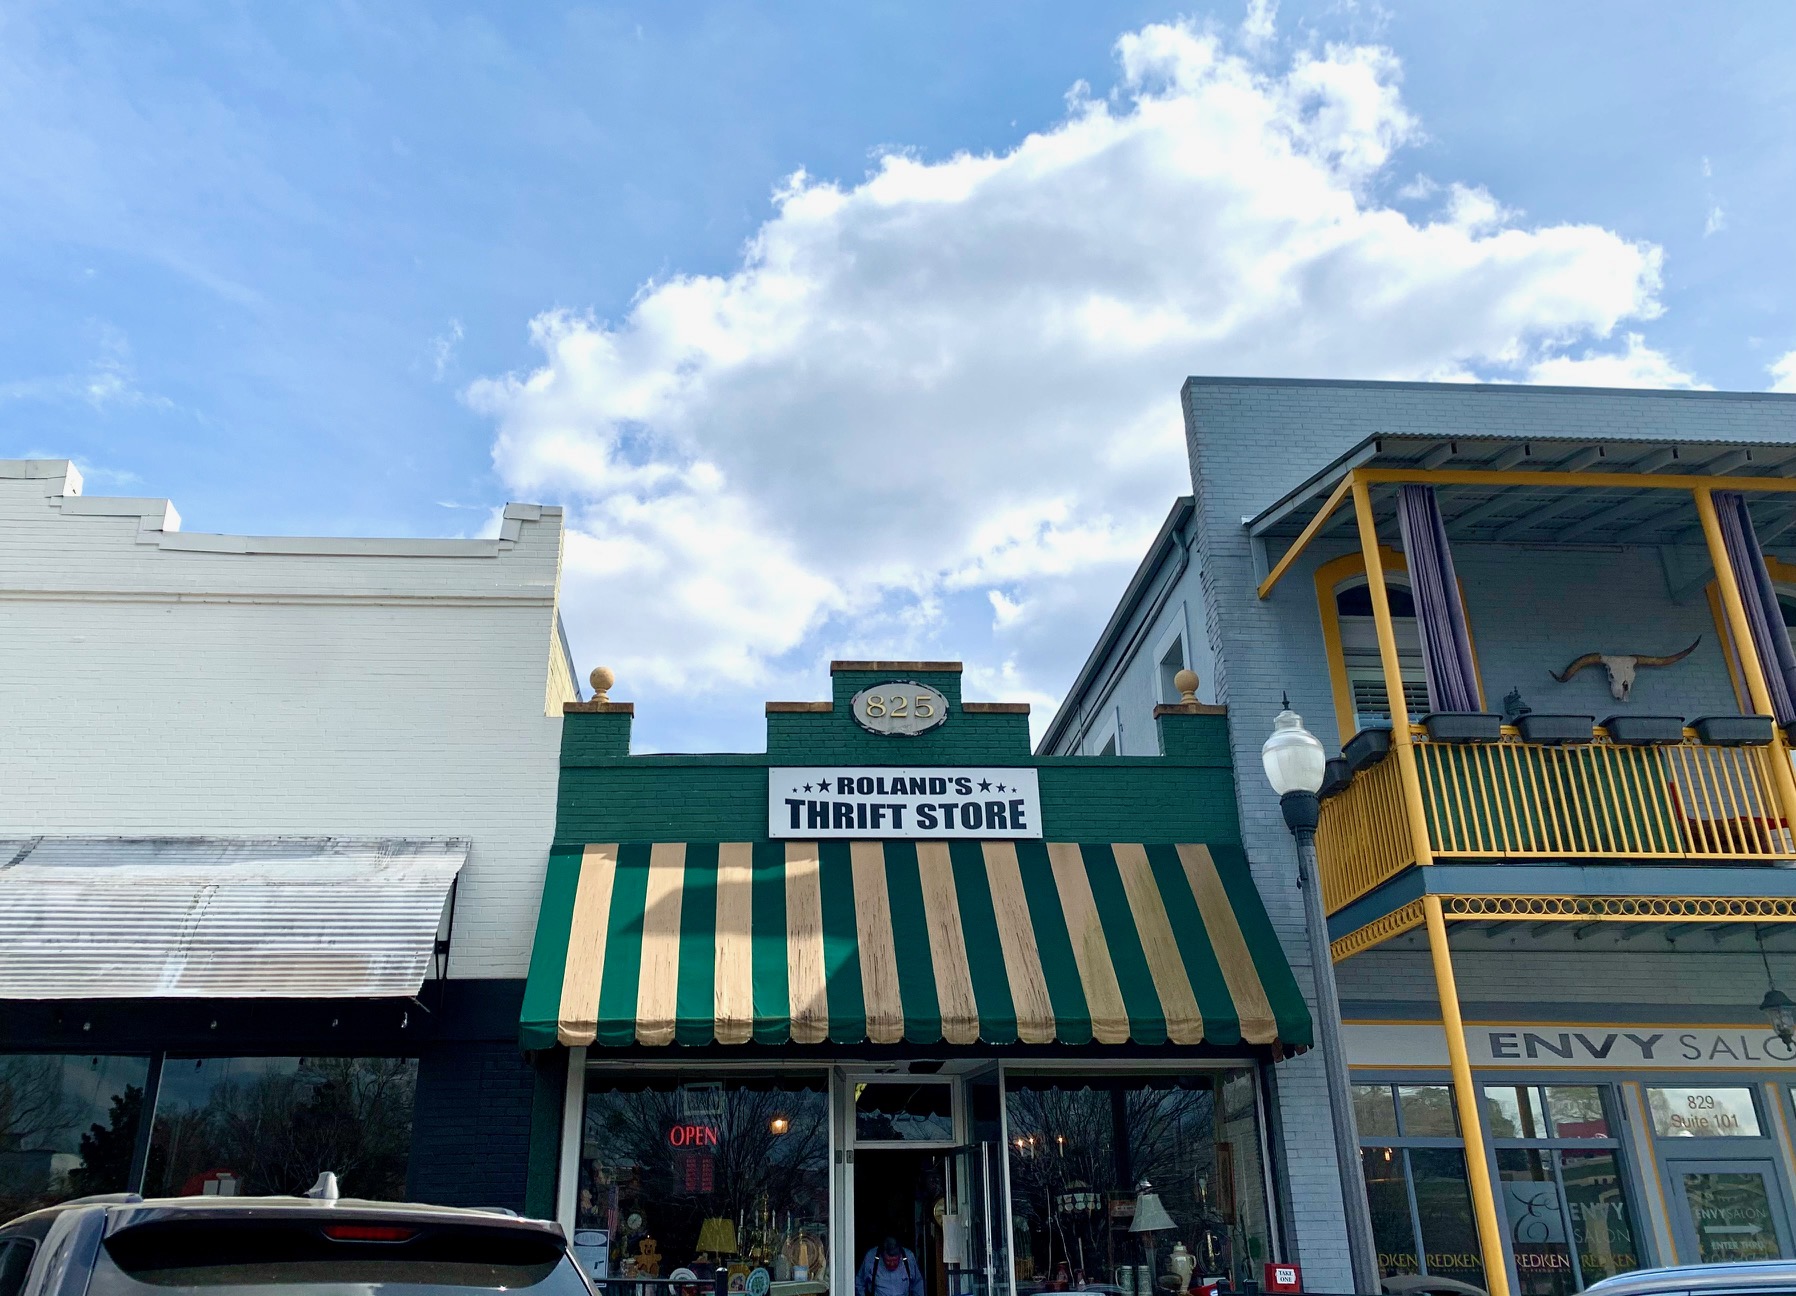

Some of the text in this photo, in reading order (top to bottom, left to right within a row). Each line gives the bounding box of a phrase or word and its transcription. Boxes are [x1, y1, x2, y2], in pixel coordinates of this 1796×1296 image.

[866, 695, 934, 718] 825
[837, 776, 972, 795] ROLAND'S
[785, 798, 1028, 830] THRIFT STORE
[1488, 1032, 1664, 1060] ENVY
[1687, 1095, 1715, 1110] 829
[1671, 1114, 1739, 1129] Suite 101
[670, 1125, 718, 1146] OPEN
[1378, 1253, 1419, 1268] DKEN
[1426, 1253, 1482, 1268] REDKEN
[1514, 1253, 1570, 1268] REDKEN
